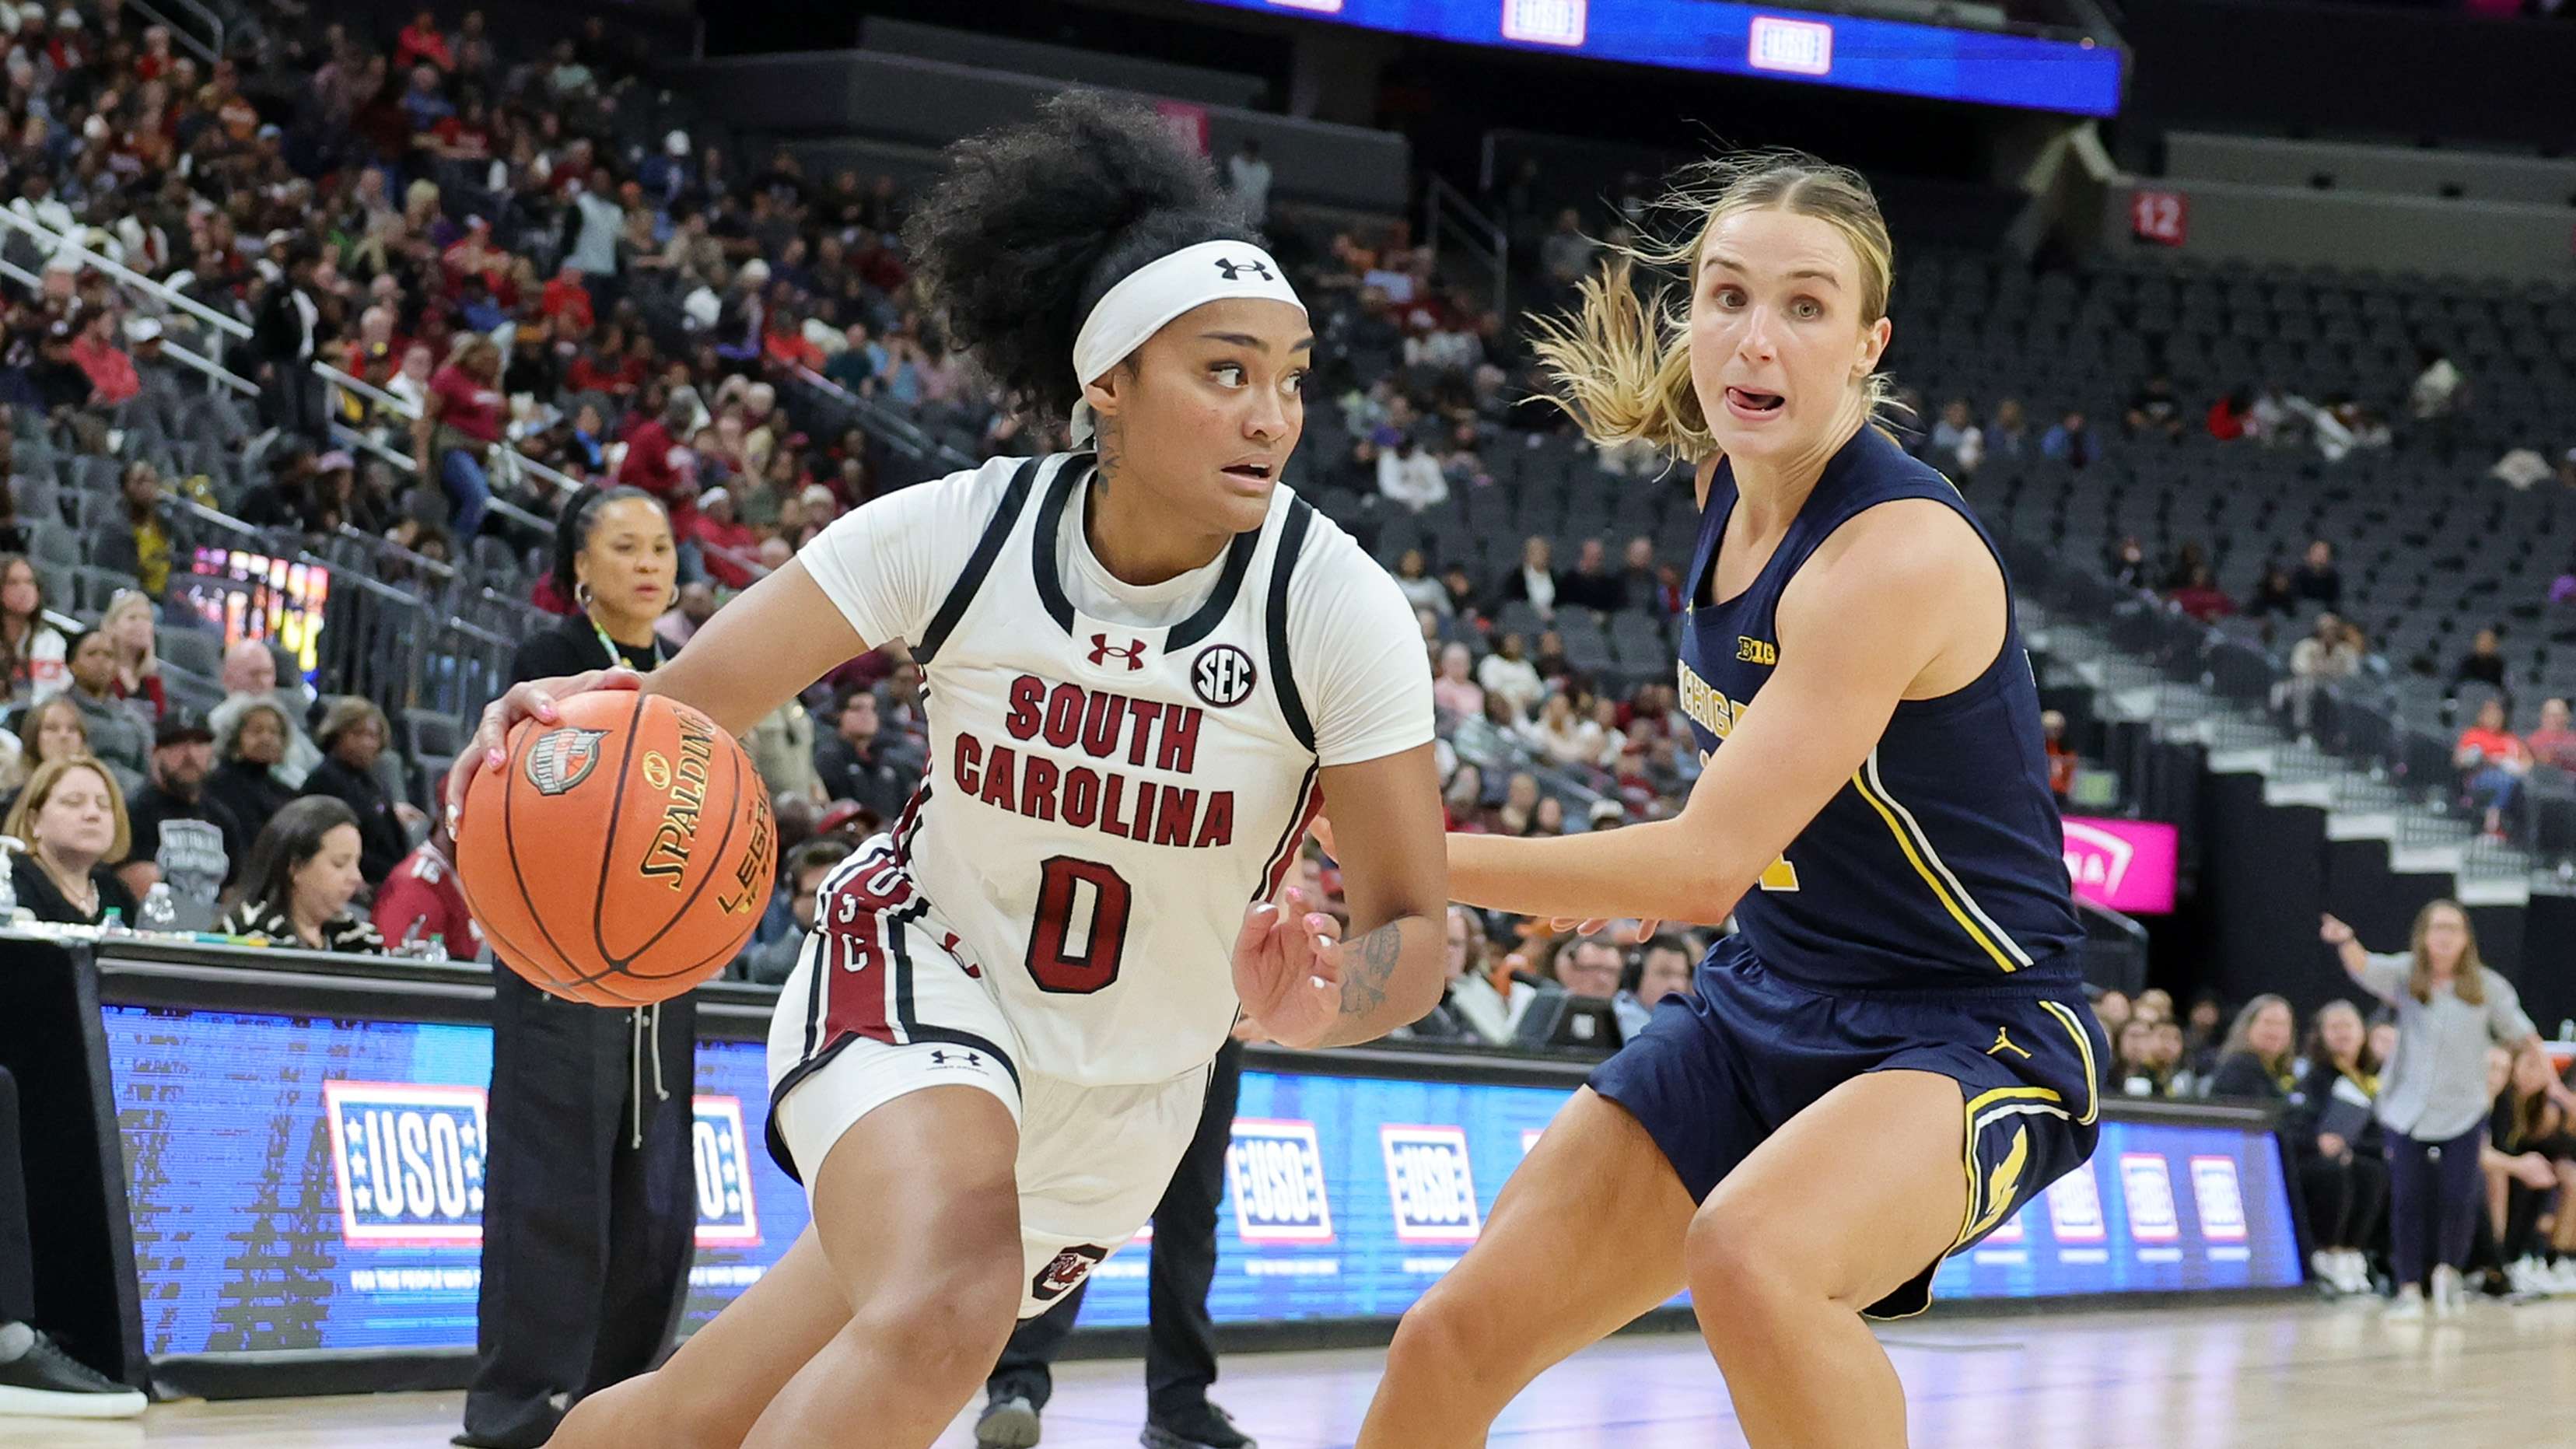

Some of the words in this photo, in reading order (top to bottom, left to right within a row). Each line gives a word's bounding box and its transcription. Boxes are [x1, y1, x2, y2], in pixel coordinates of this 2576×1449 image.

[2140, 197, 2179, 236] 12
[1006, 674, 1203, 775] SOUTH
[1196, 647, 1252, 703] SEC
[639, 705, 716, 892] SPALDING
[954, 732, 1234, 849] CAROLINA
[1024, 854, 1132, 995] 0
[364, 1110, 467, 1219] USO
[1245, 1139, 1311, 1223] USO
[1401, 1146, 1461, 1223] USO
